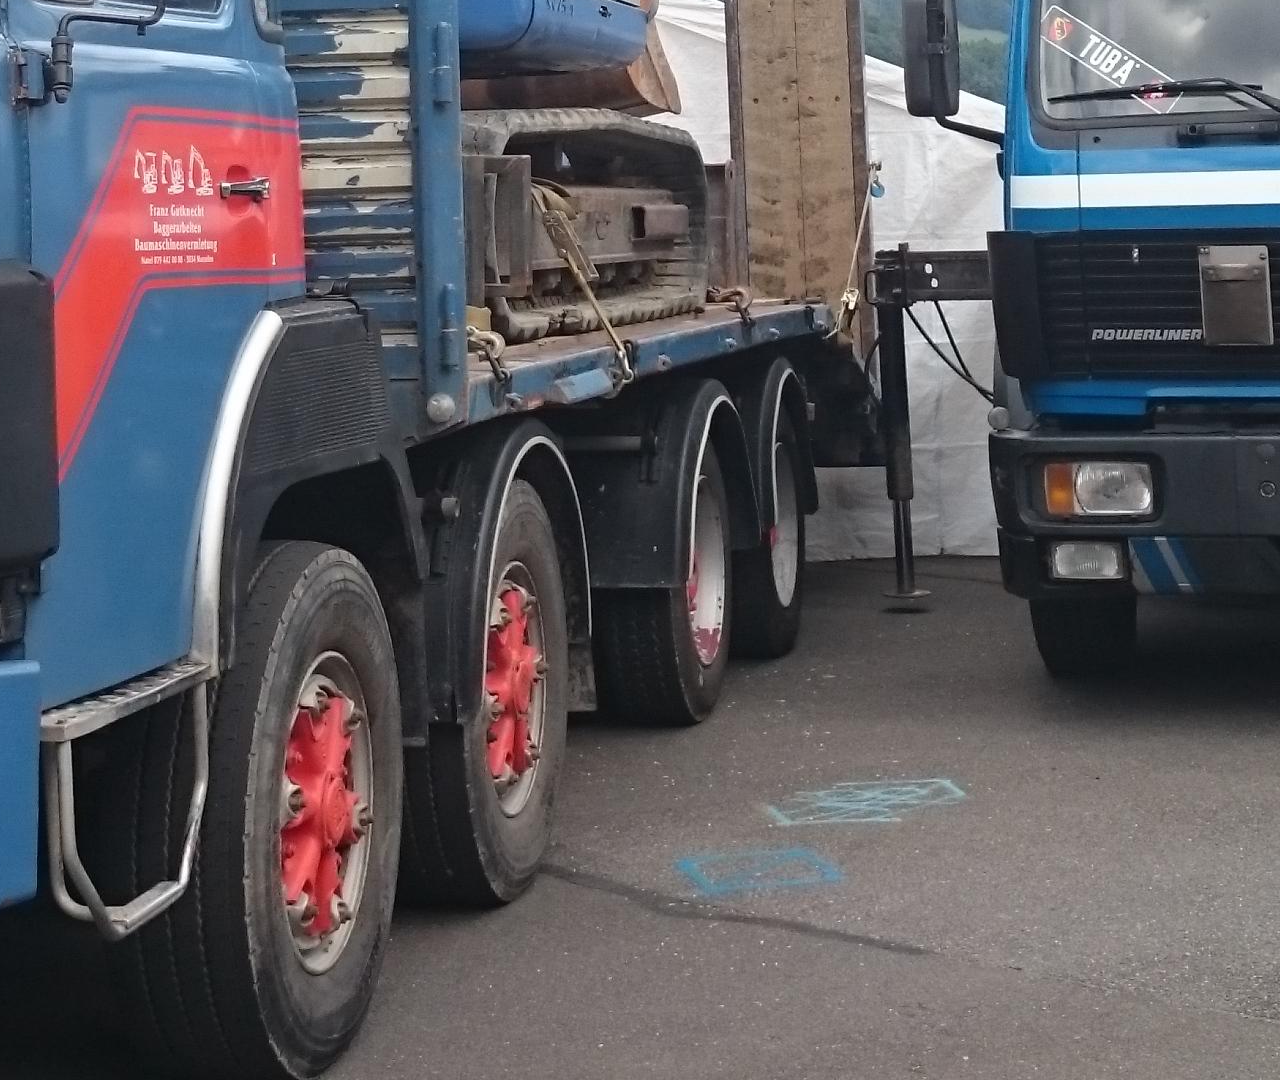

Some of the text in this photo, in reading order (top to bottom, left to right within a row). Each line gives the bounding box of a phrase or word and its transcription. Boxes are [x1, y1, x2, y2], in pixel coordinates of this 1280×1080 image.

[149, 204, 205, 217] Franz Gutknecht
[153, 221, 202, 237] Baggerarbeiten
[1091, 328, 1203, 341] POWERLINER
